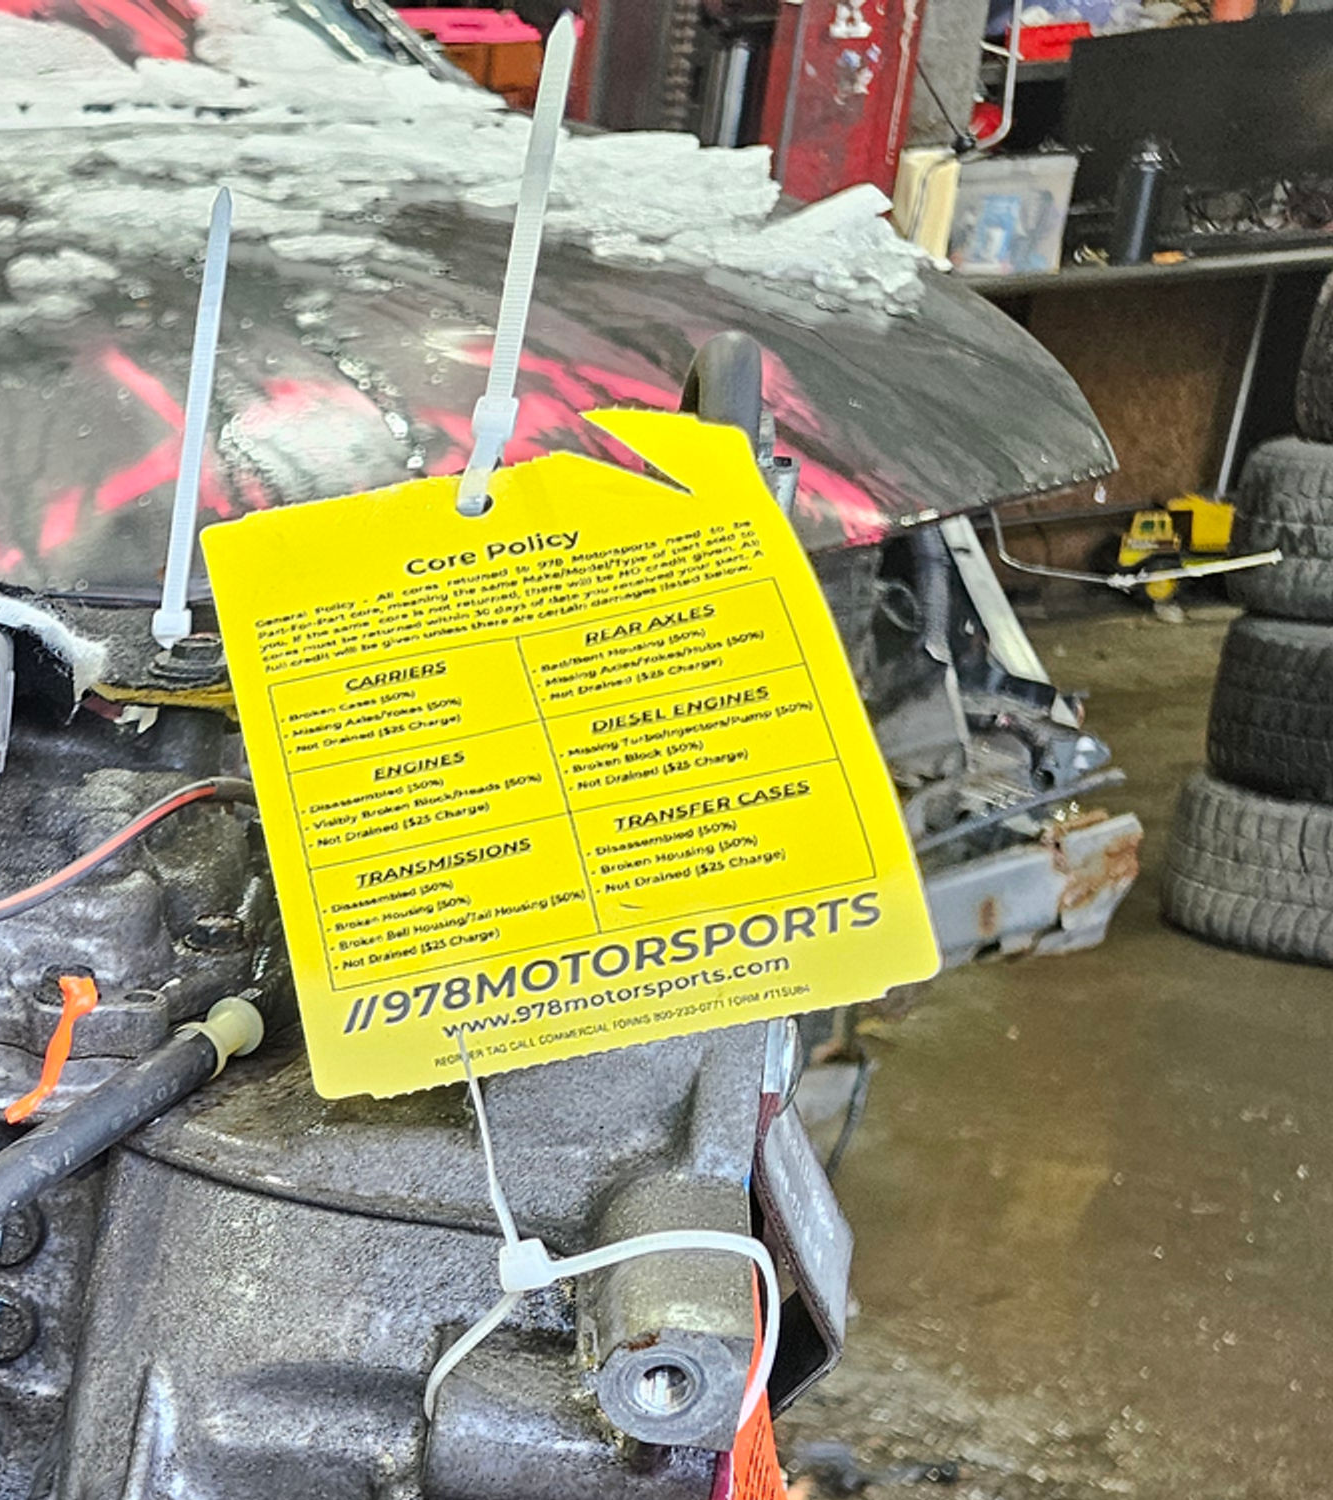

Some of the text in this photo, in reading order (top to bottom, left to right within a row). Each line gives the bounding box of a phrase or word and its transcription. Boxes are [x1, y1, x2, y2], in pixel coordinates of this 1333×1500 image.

[405, 530, 578, 575] Core Policy
[584, 603, 715, 646] REAR AXLES
[607, 638, 665, 657] Housing
[668, 627, 706, 645] (50%)
[345, 660, 446, 691] CARRIERS
[544, 669, 597, 687] Missing
[726, 629, 764, 647] (50%)
[549, 656, 723, 700] Not Drained ($25 Charge)
[288, 690, 415, 722] Broken Cases (50%)
[292, 697, 462, 737] Missing Axles/Yokes (50%)
[591, 685, 768, 734] DIESEL ENGINES
[295, 713, 461, 752] Not Drained ($25 Charge)
[567, 740, 619, 756] Missing
[774, 700, 813, 717] (50%)
[373, 750, 464, 781] ENGINES
[572, 739, 704, 773] Broken Block (50%)
[577, 748, 748, 790] Not Drained ($25 Charge)
[309, 778, 444, 814] Disassembled (50%)
[312, 772, 542, 829] Visibly Broken Block/Heads (50%)
[613, 779, 810, 832] TRANSFER CASES
[316, 801, 490, 847] Not Drained ($25 Charge)
[594, 819, 737, 856] Disassembled (50%)
[355, 837, 531, 888] TRANSMISSIONS
[599, 834, 758, 874] Broken Housing (50%)
[604, 848, 786, 893] Not Drained ($25 Charge)
[330, 879, 453, 913] Disassembled (50%)
[334, 895, 471, 931] Broken Housing (50%)
[338, 888, 586, 951] Broken Bell Housing/Tail Housing (50%)
[342, 927, 500, 970] Not Drained ($25 Charge)
[343, 891, 881, 1034] //978MOTORSPORTS
[441, 956, 789, 1040] www.978motorsports.com
[433, 1048, 484, 1067] REORER
[485, 1042, 508, 1055] TAG
[508, 1037, 535, 1051] CALL
[537, 1022, 610, 1045] COMMERCIAL
[727, 991, 760, 1007] FORM
